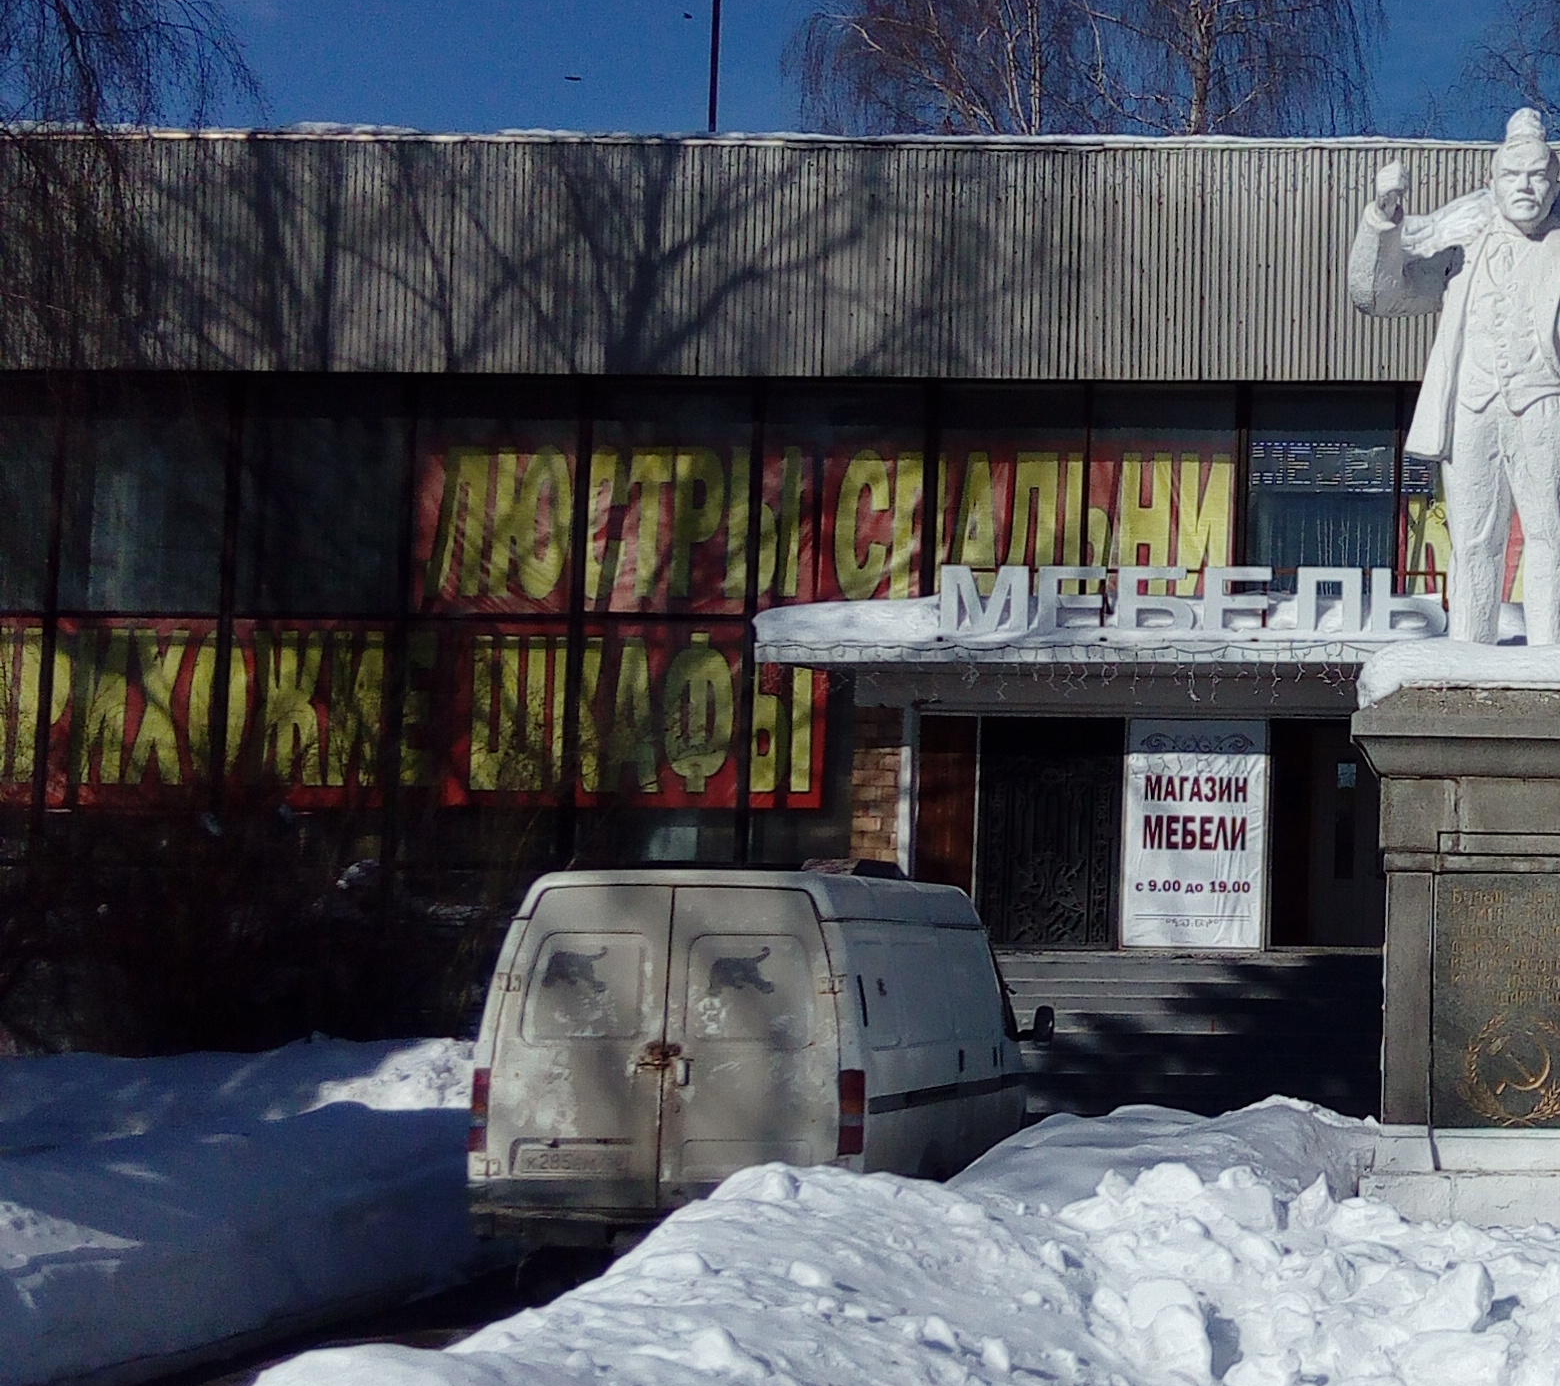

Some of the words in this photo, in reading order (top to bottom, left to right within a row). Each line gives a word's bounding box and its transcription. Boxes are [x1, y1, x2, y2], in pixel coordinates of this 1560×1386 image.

[424, 446, 803, 599] ЛЮСТРЫ
[834, 449, 1235, 601] СПАЛЬНИ
[939, 565, 1448, 634] МЕБЕЛЬ
[0, 625, 438, 787] РИХОЖИЕ
[469, 632, 813, 793] ШКАФЫ
[1142, 814, 1248, 851] МЕБЕЛИ
[1144, 775, 1248, 803] МАГАЗИН
[1148, 880, 1182, 893] 9.00
[1185, 881, 1204, 894] до
[1209, 880, 1251, 894] 19.00
